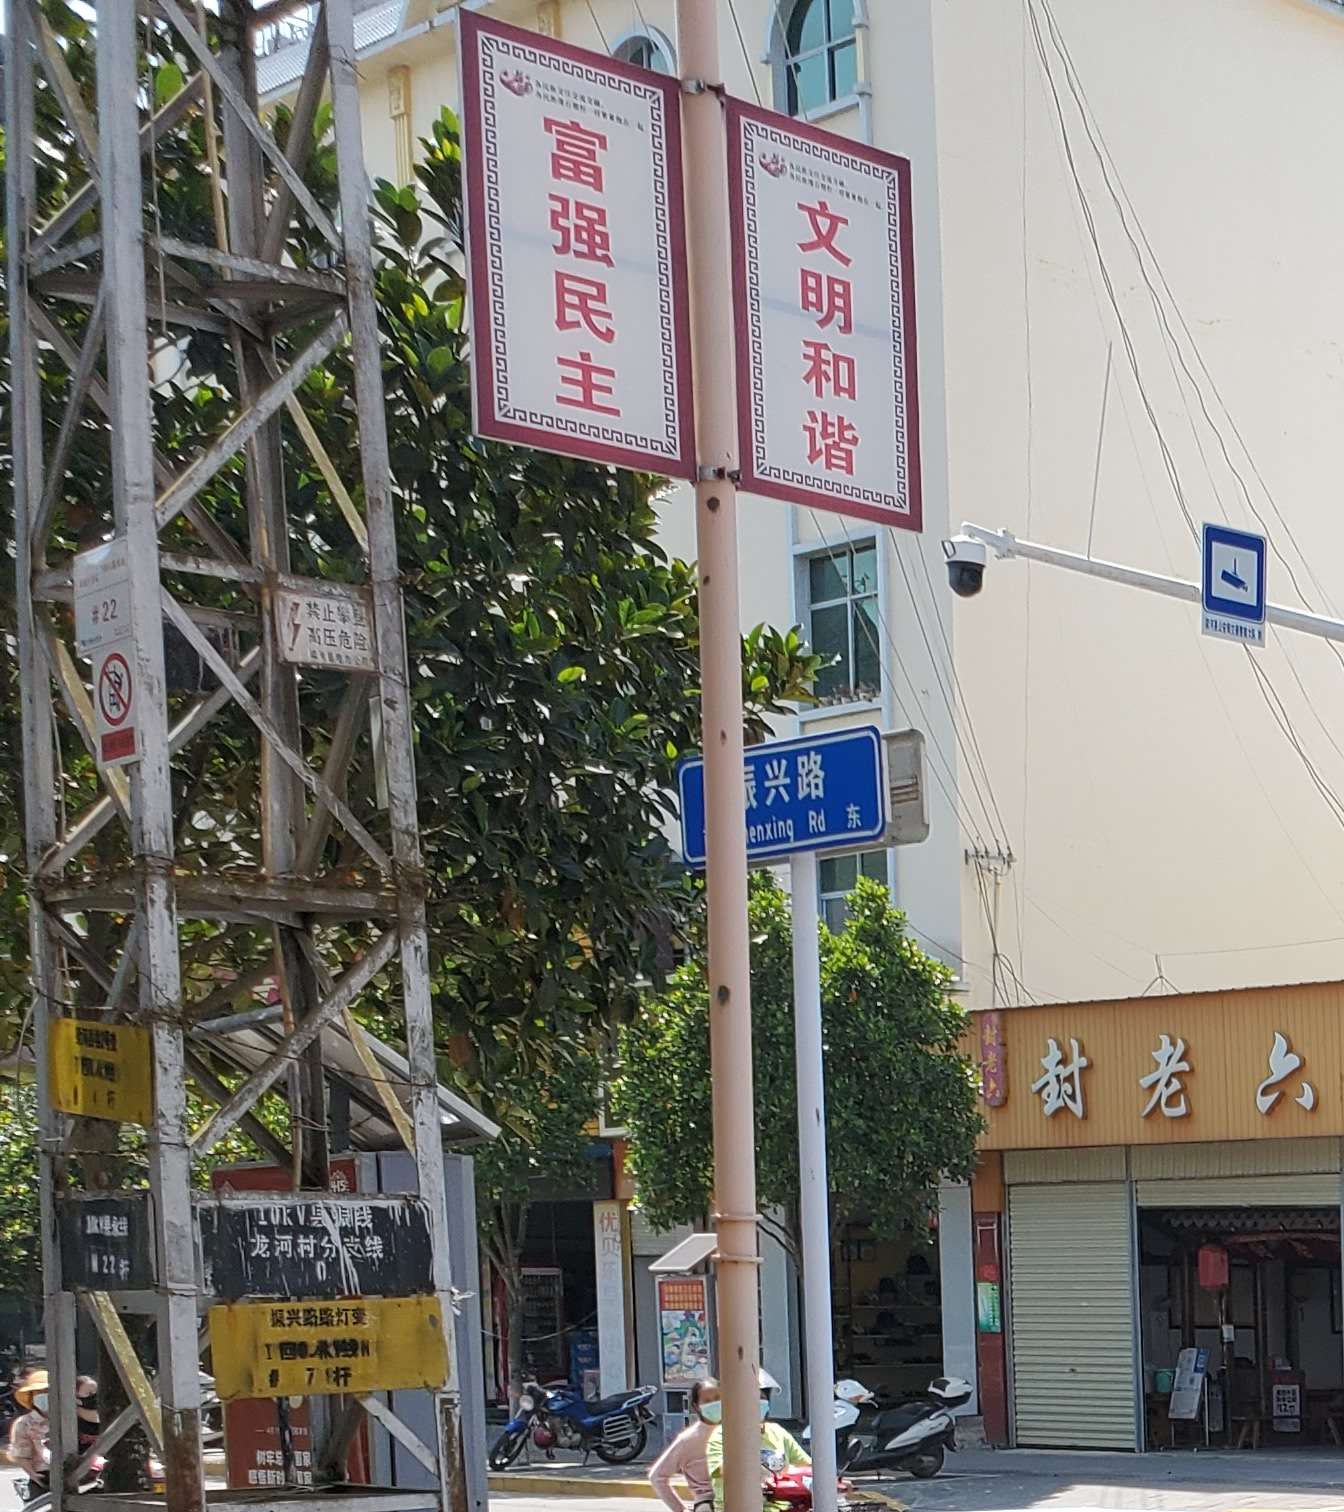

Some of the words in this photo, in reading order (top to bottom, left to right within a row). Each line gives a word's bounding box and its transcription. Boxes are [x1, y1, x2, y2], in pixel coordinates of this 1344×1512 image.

[543, 116, 621, 418] 富强民主
[797, 200, 859, 476] 文明和谐
[809, 809, 826, 833] Rd
[847, 803, 861, 828] 东
[1032, 1032, 1317, 1120] 封老六
